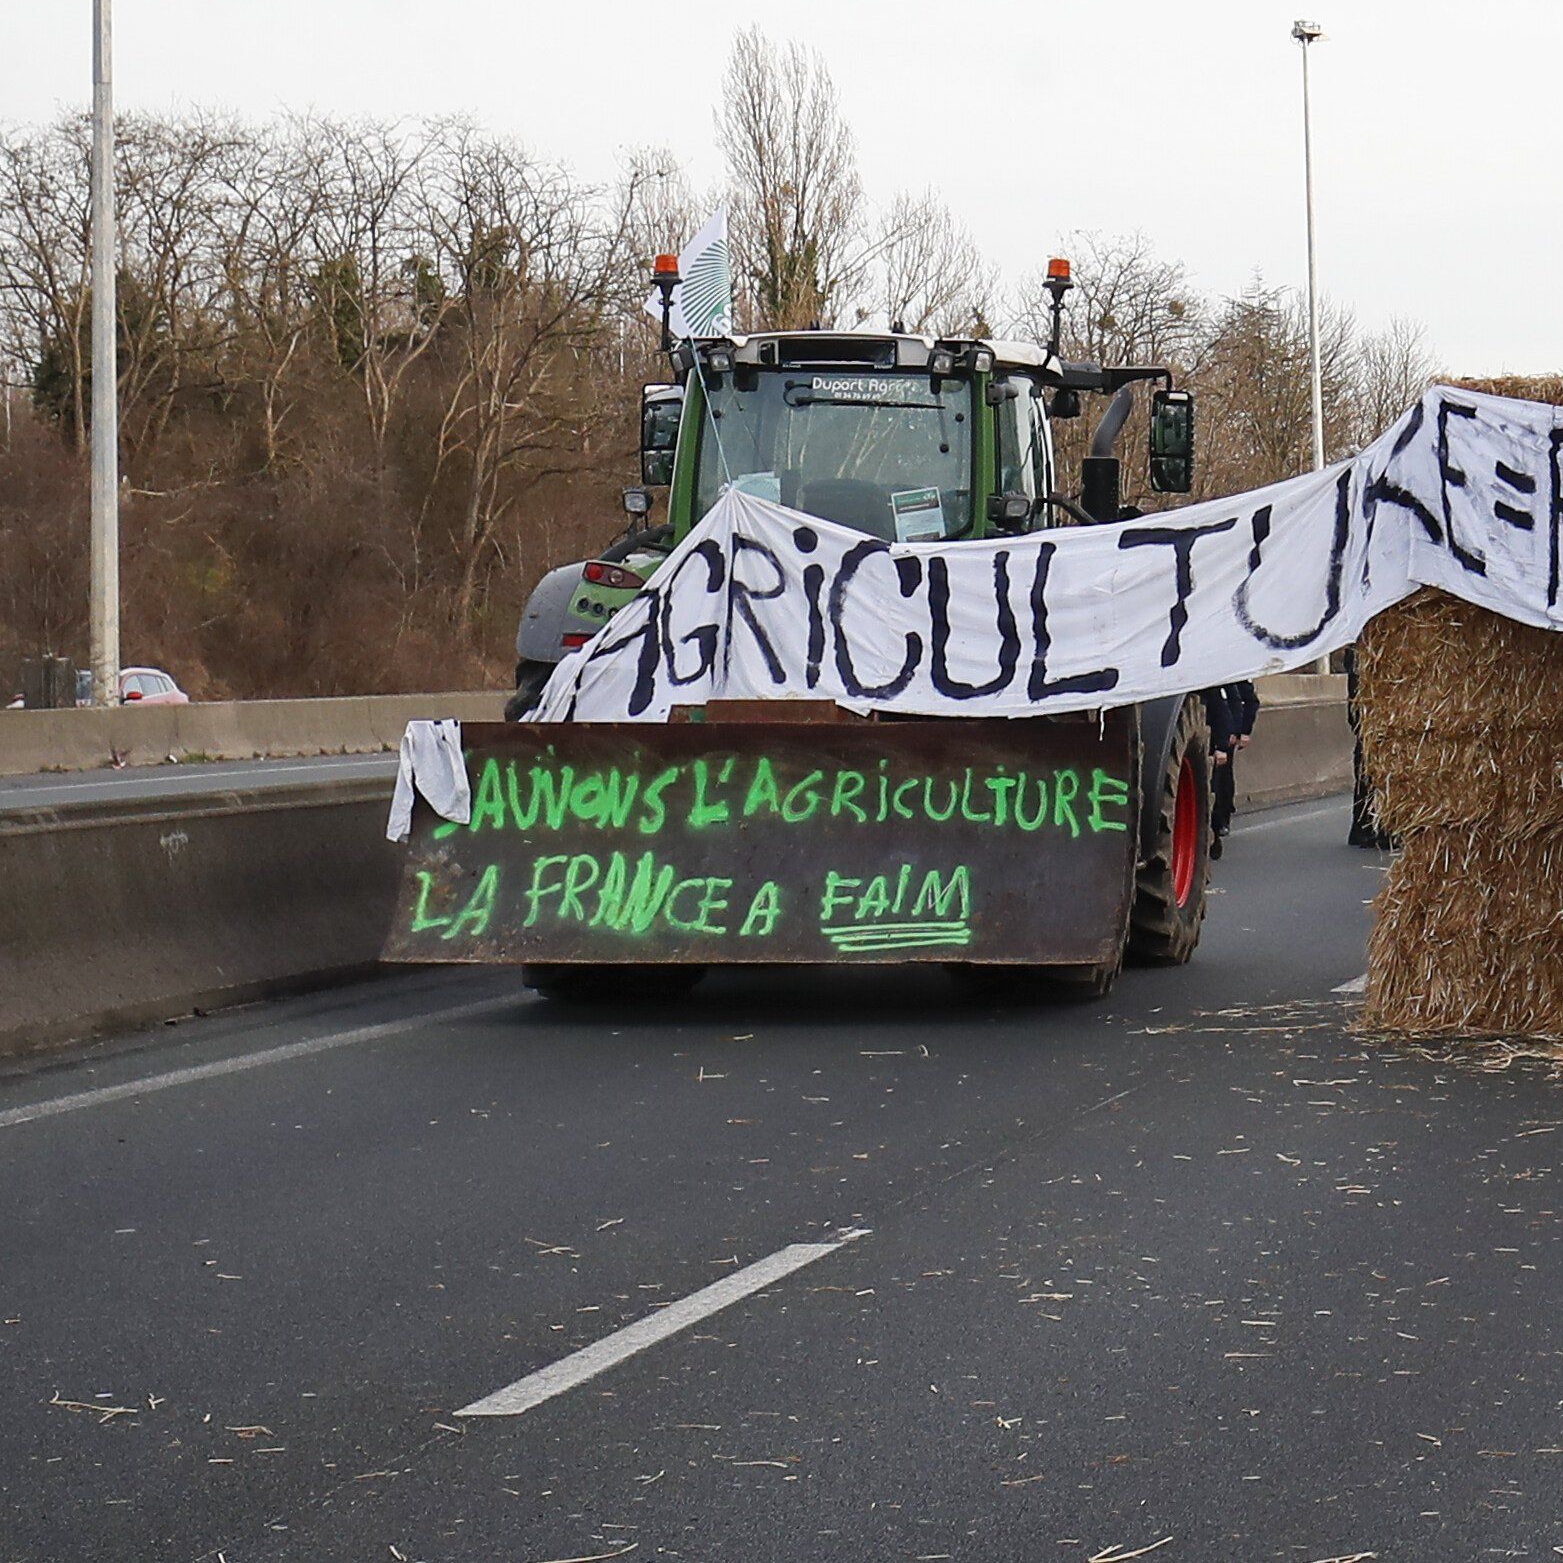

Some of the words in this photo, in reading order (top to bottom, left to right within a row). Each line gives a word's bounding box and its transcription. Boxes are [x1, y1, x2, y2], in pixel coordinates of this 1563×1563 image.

[811, 376, 864, 394] Duport
[433, 750, 682, 838] AUVONS
[411, 863, 498, 939] LA
[523, 850, 732, 935] FRANCE
[740, 881, 781, 936] A
[819, 863, 972, 921] FAIM
